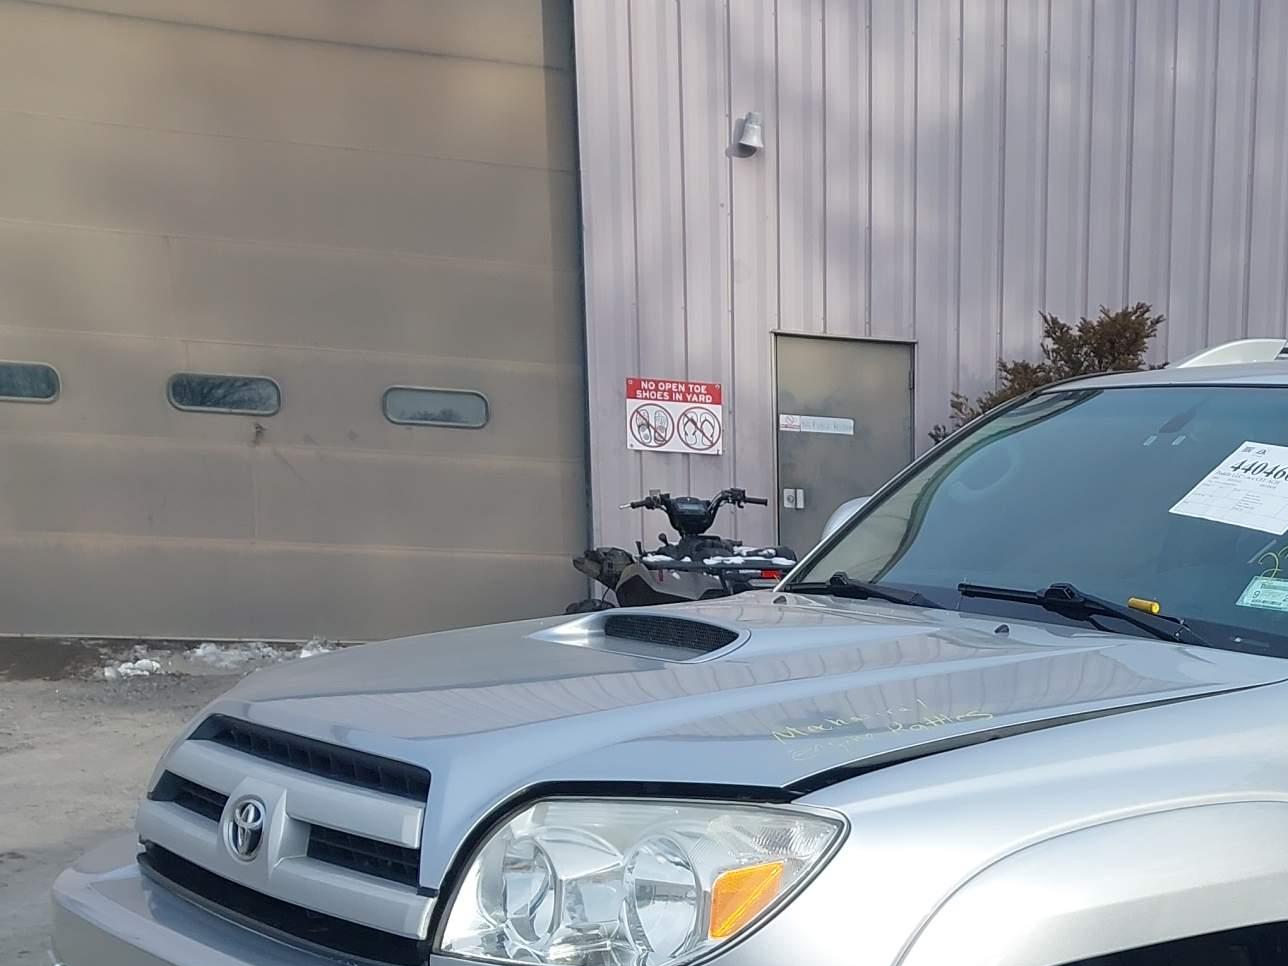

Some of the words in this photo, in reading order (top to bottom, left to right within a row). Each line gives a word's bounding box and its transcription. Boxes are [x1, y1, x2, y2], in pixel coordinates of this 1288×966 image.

[641, 381, 656, 390] NO
[658, 382, 685, 392] OPEN
[688, 384, 707, 394] TOE
[636, 389, 670, 400] SHOES
[672, 392, 683, 401] IN
[686, 393, 713, 403] YARD
